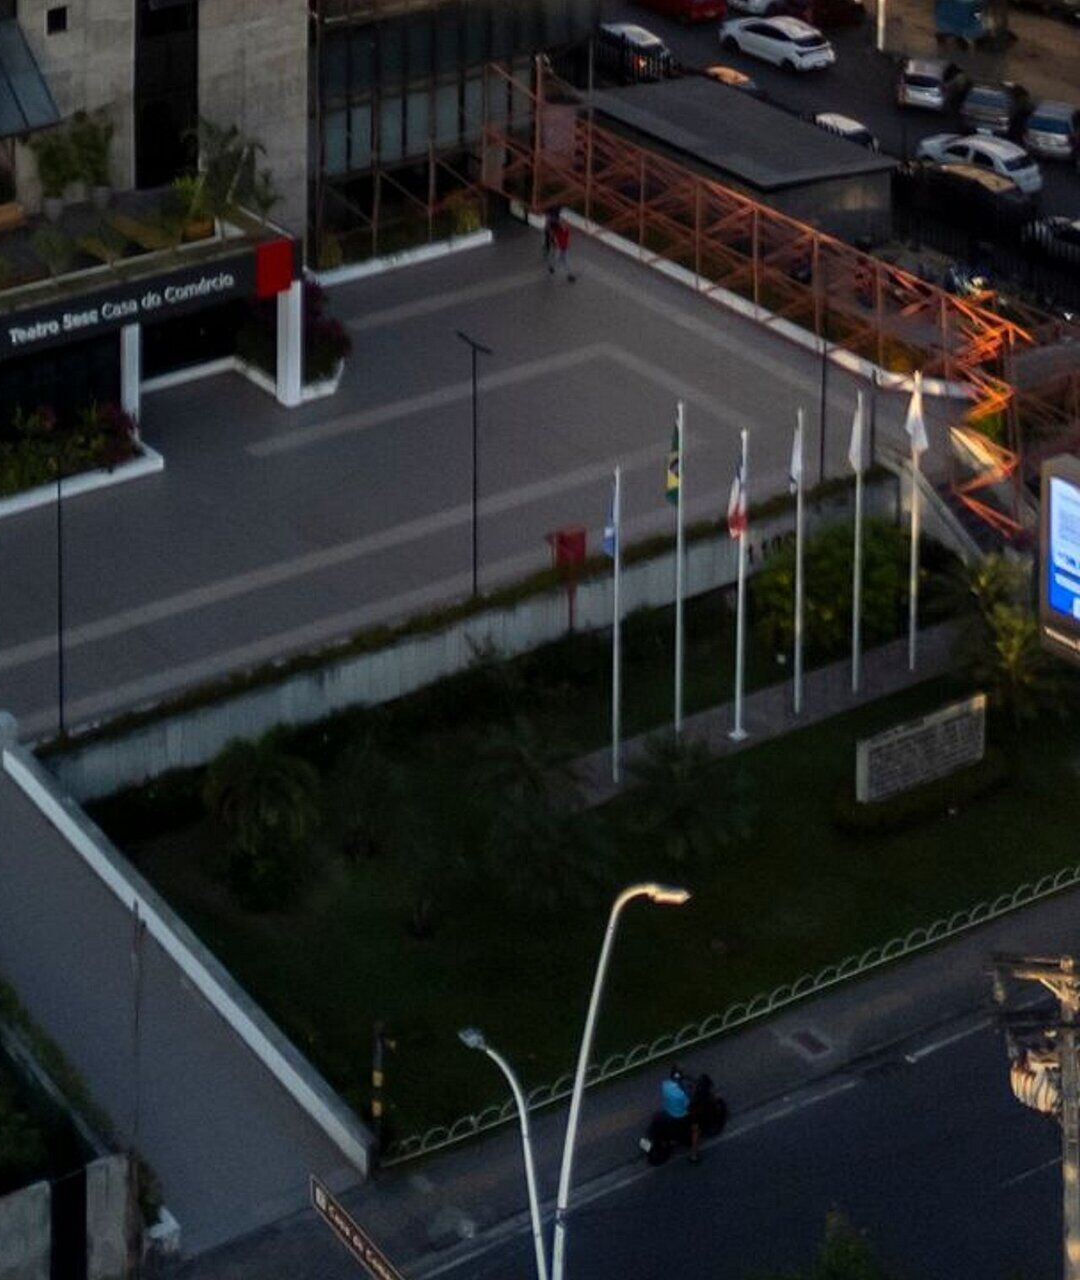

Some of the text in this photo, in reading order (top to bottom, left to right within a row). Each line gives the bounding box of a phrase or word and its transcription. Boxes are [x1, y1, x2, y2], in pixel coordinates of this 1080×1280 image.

[9, 272, 234, 345] Teatro Sesc Casa do Comércio
